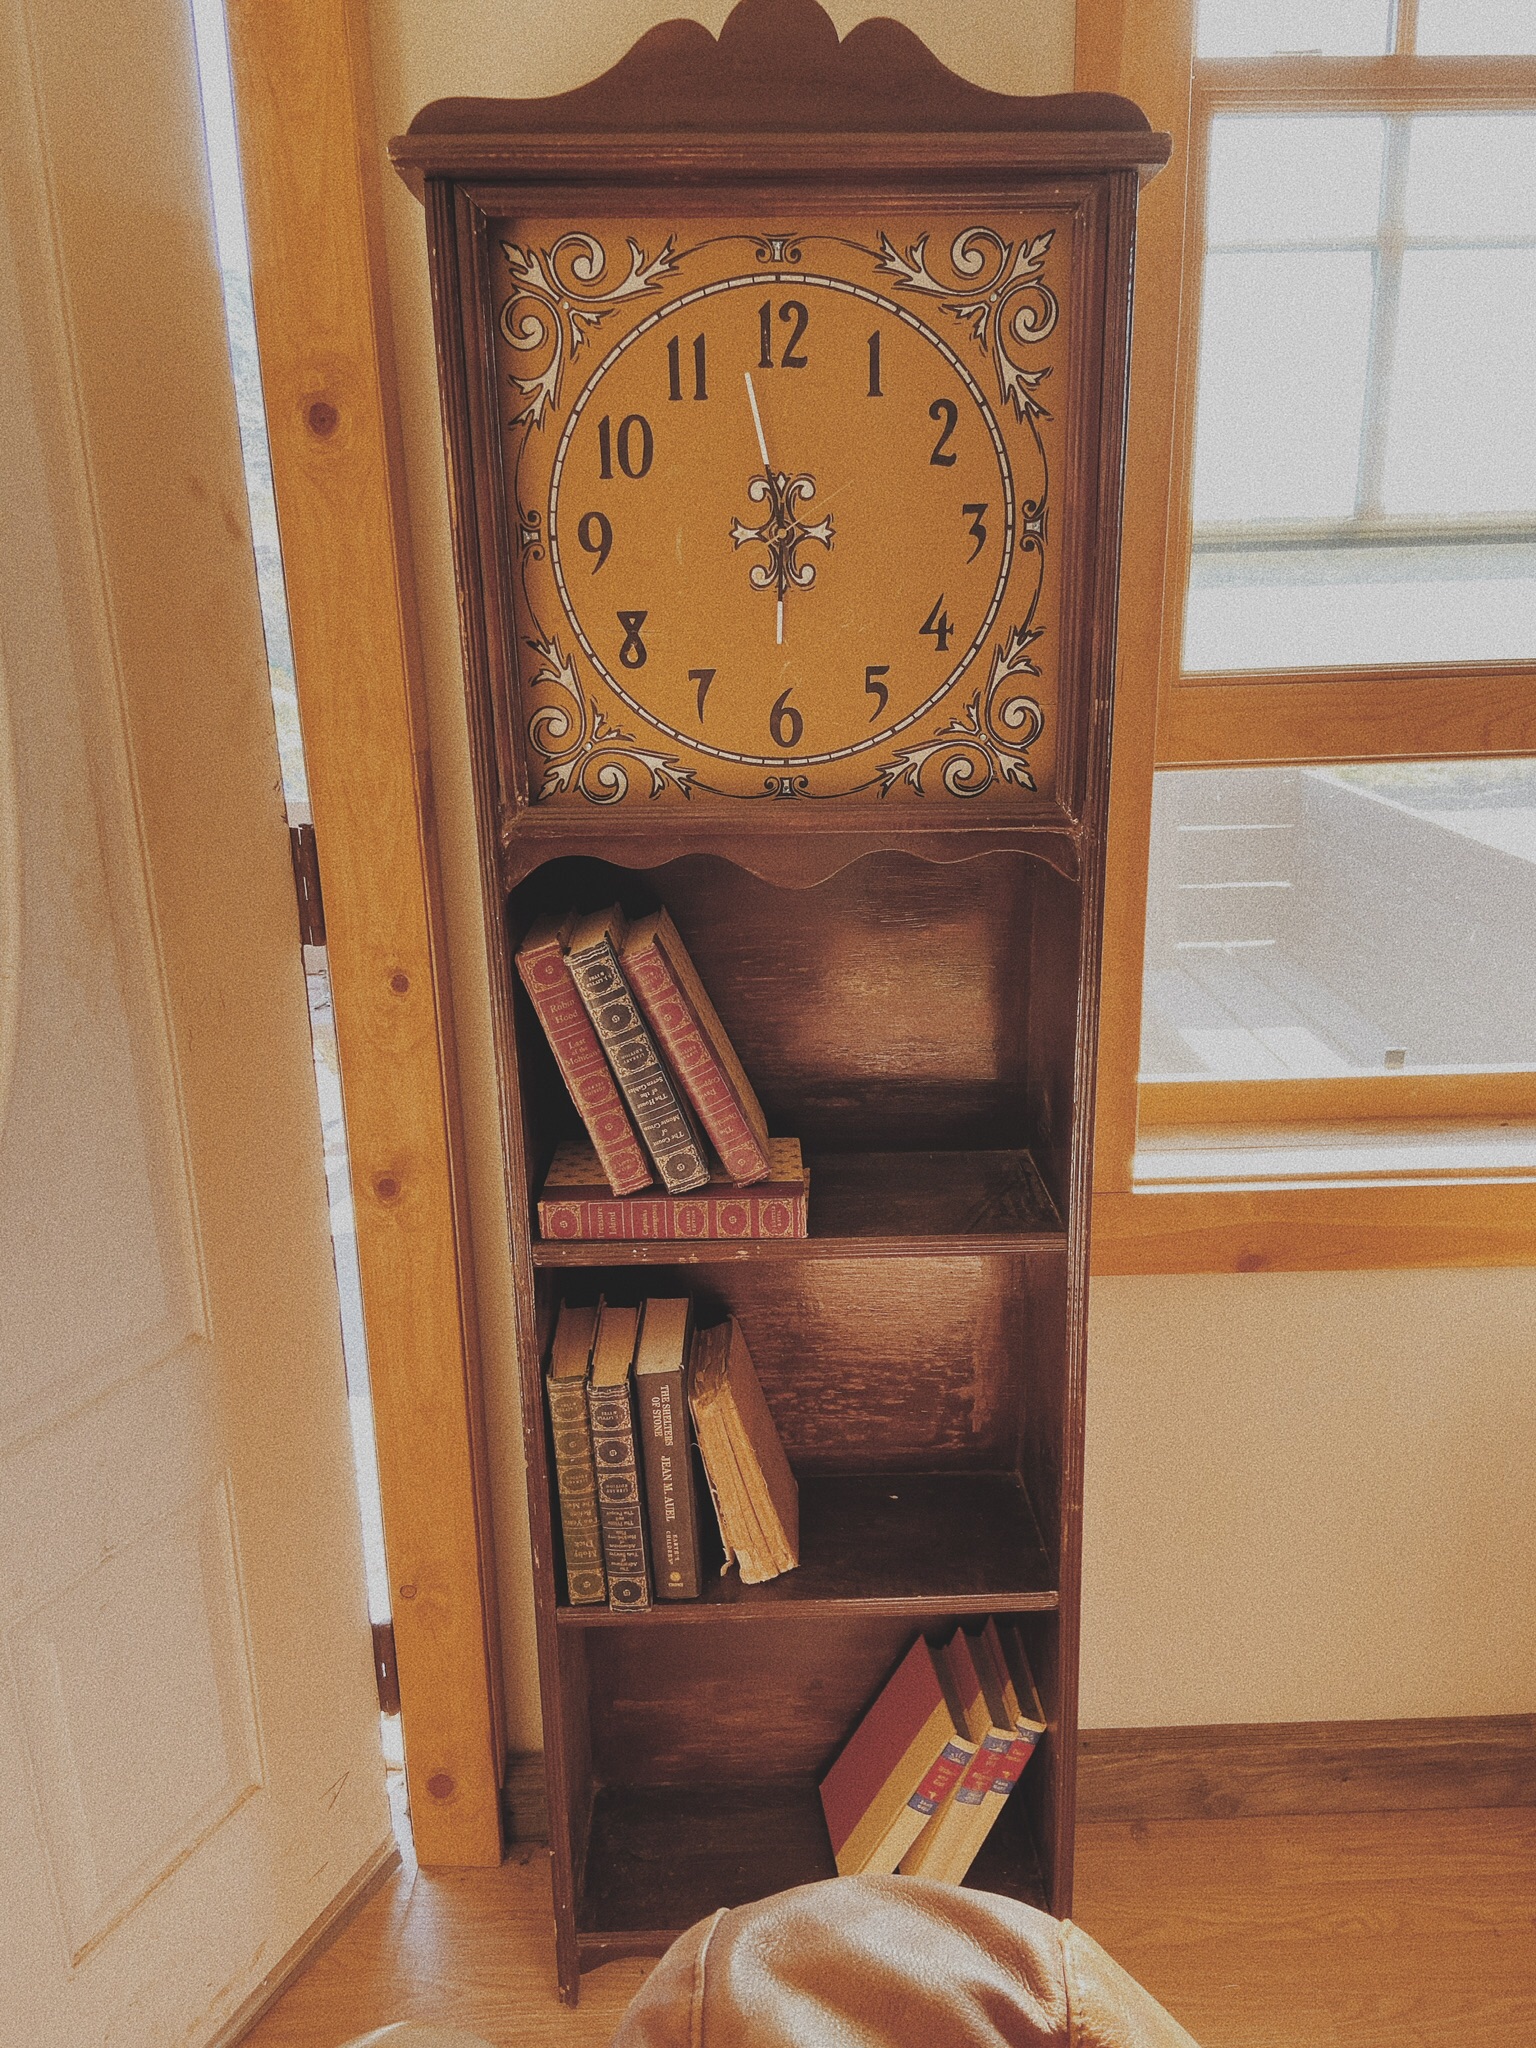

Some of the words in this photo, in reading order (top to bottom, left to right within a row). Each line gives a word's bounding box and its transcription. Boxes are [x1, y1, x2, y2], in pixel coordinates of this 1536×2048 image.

[757, 300, 809, 369] 12
[666, 333, 708, 400] 11
[866, 330, 883, 397] 1
[928, 398, 959, 467] 2
[597, 414, 654, 479] 10
[577, 511, 613, 575] 9
[961, 503, 989, 565] 3
[918, 592, 954, 651] 4
[616, 610, 648, 669] 8
[688, 668, 717, 724] 7
[864, 665, 890, 723] 5
[769, 687, 803, 748] 6
[549, 999, 575, 1014] Robin
[554, 1011, 578, 1024] Hood
[568, 1038, 586, 1050] Last
[566, 1049, 599, 1065] Mohicans
[623, 1052, 645, 1064] LIBRARY
[628, 1084, 647, 1094] Gables
[646, 1076, 664, 1088] Seven
[651, 1088, 658, 1096] of
[656, 1094, 668, 1103] The
[701, 1088, 717, 1100] Davi
[637, 1098, 656, 1109] House
[661, 1114, 680, 1126] Monte
[661, 1128, 668, 1136] of
[670, 1131, 685, 1140] The
[720, 1126, 734, 1135] The
[653, 1137, 671, 1146] Count
[596, 1206, 605, 1238] Treasure
[607, 1211, 616, 1234] Island
[640, 1209, 649, 1235] Captains
[651, 1397, 661, 1407] OF
[660, 1385, 670, 1403] THE
[653, 1409, 663, 1437] STONE
[662, 1404, 674, 1447] SHELTERS
[661, 1455, 673, 1481] JEAN
[663, 1483, 673, 1495] M.
[664, 1496, 676, 1521] AUEL
[574, 1550, 597, 1558] Moby
